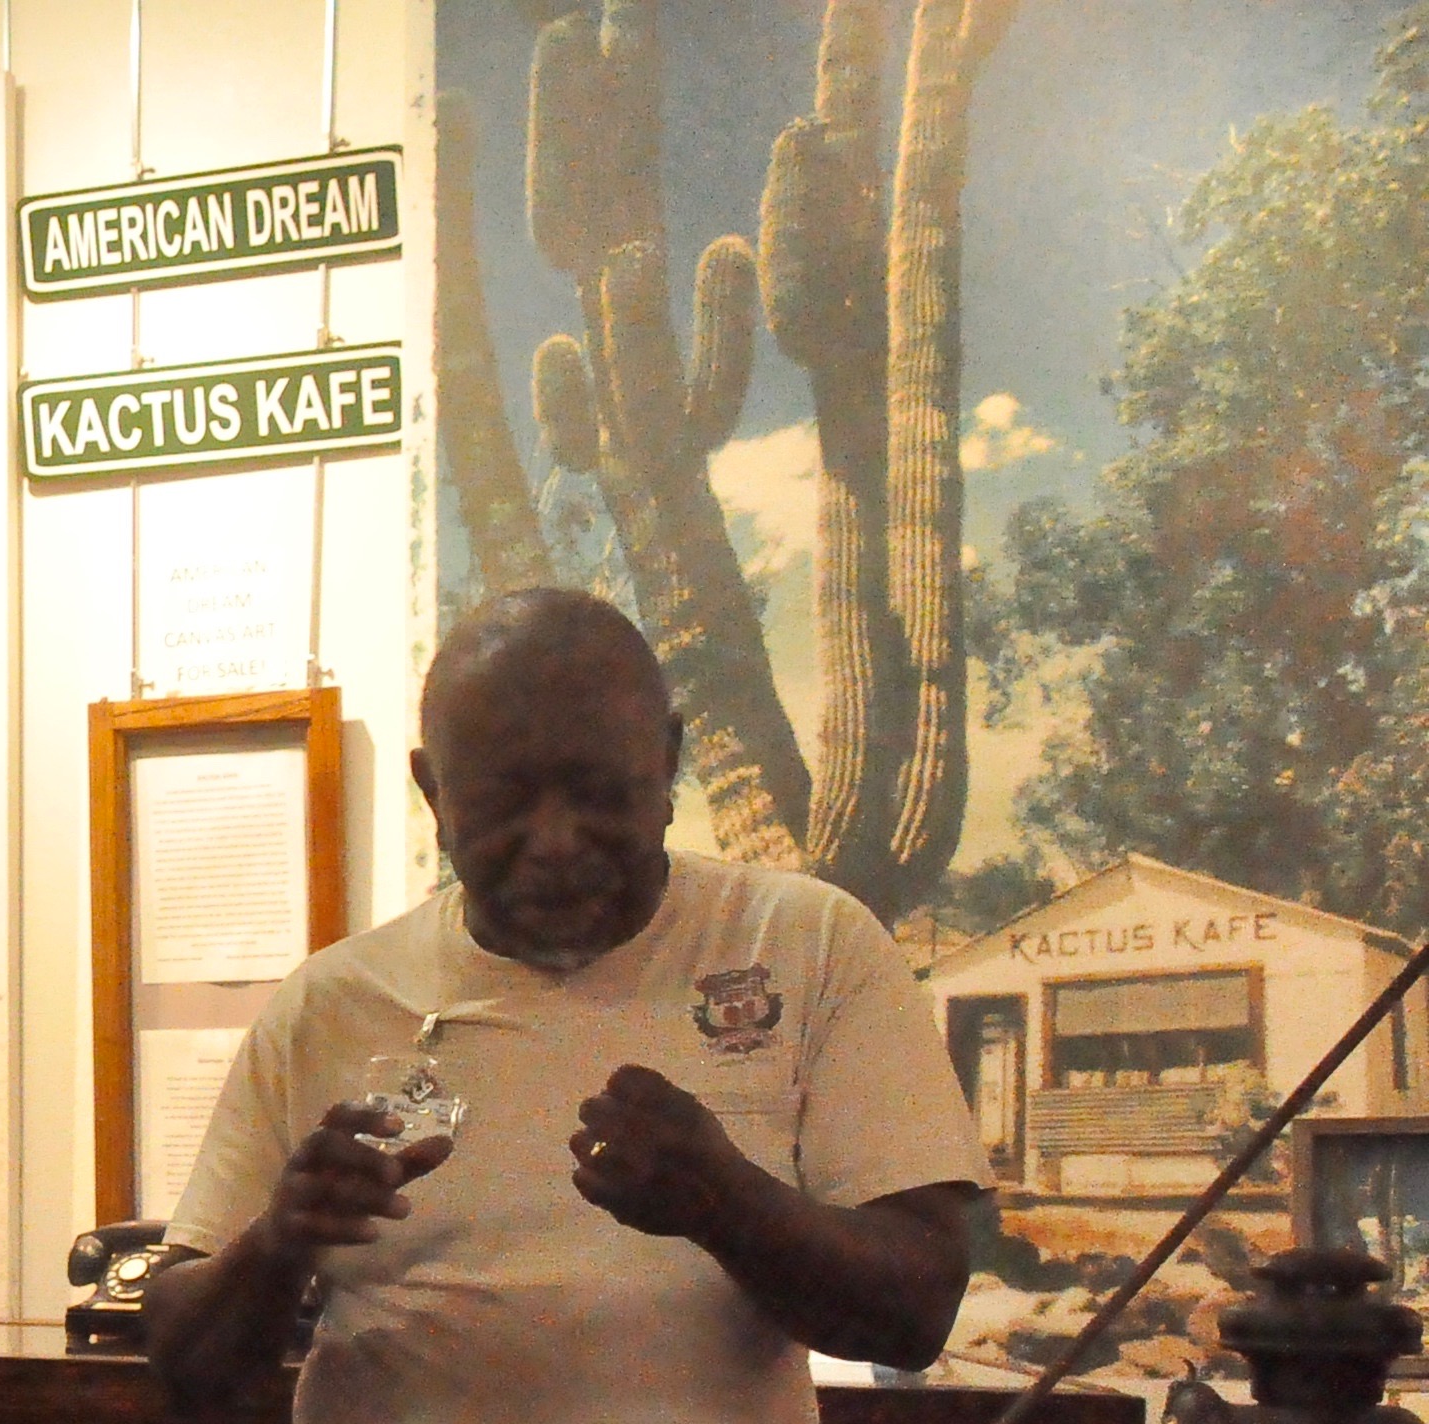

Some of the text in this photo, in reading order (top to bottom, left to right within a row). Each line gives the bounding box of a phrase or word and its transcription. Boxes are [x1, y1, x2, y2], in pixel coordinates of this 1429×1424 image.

[43, 172, 380, 273] AMERICAN DREAM
[37, 366, 395, 458] KACTUS KAFE
[170, 560, 268, 583] AMERAN
[163, 621, 277, 649] CANAS ART
[1009, 911, 1280, 964] KACTUS KAFE
